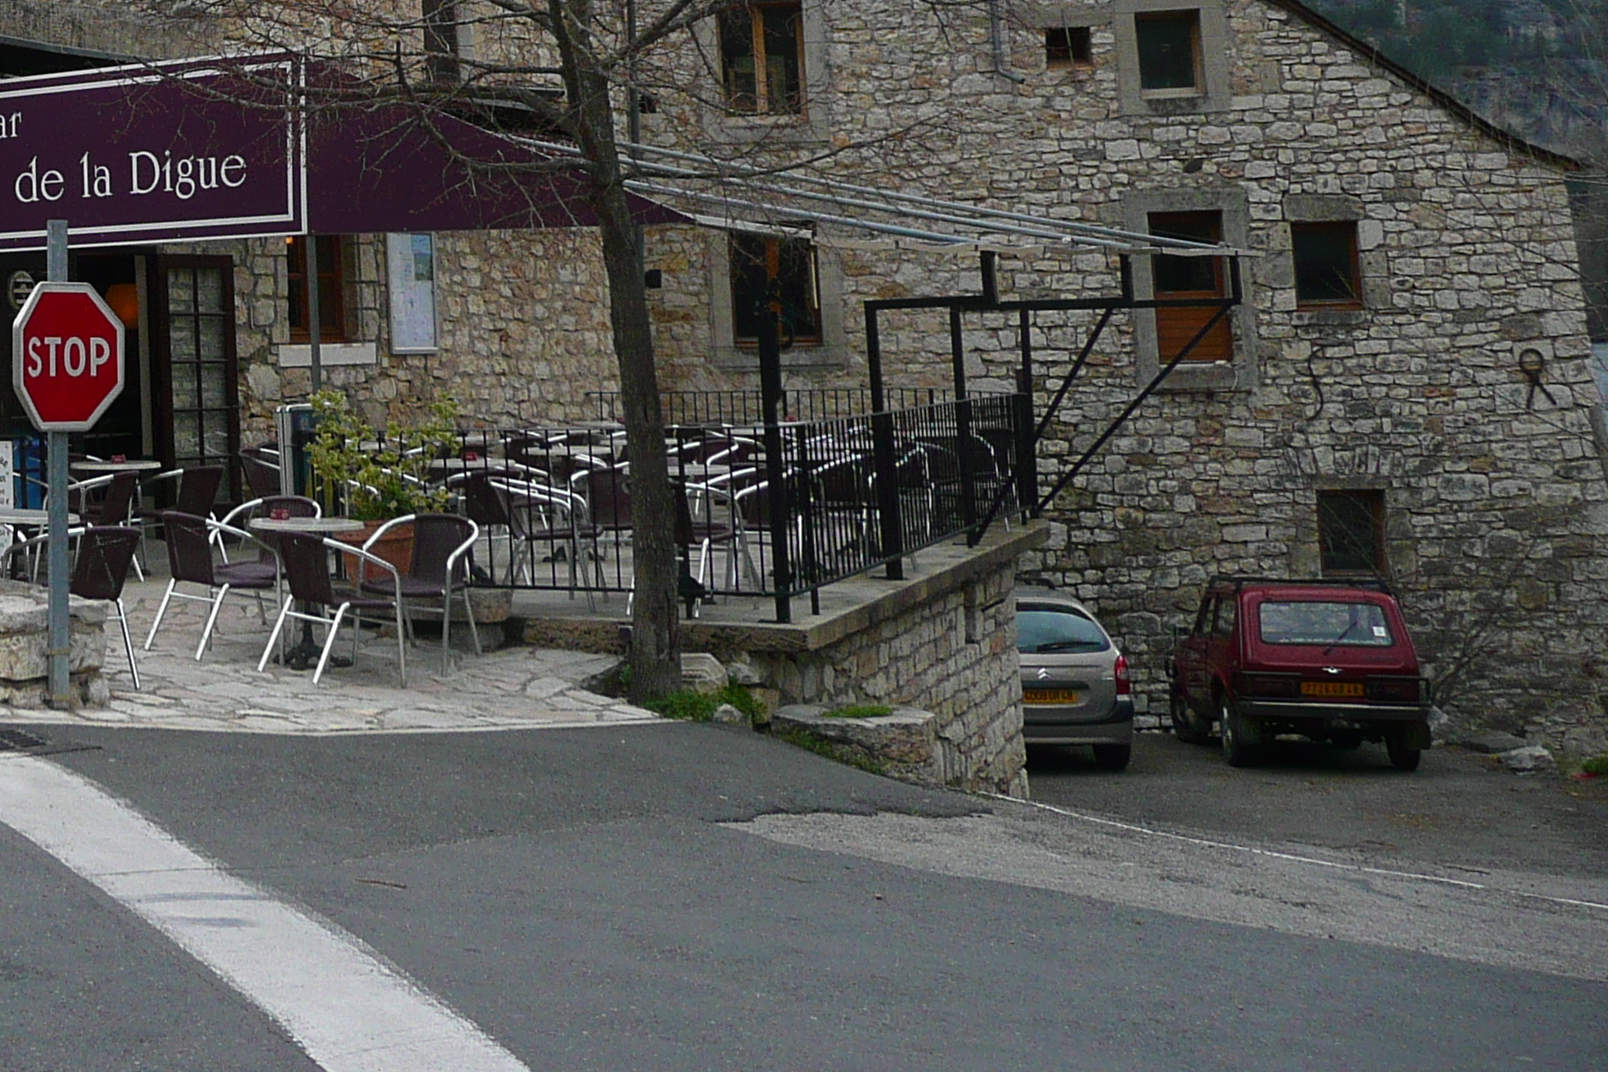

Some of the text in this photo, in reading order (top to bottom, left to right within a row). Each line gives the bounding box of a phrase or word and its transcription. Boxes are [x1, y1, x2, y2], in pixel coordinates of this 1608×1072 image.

[15, 149, 246, 203] de la Digue
[28, 337, 110, 377] STOP
